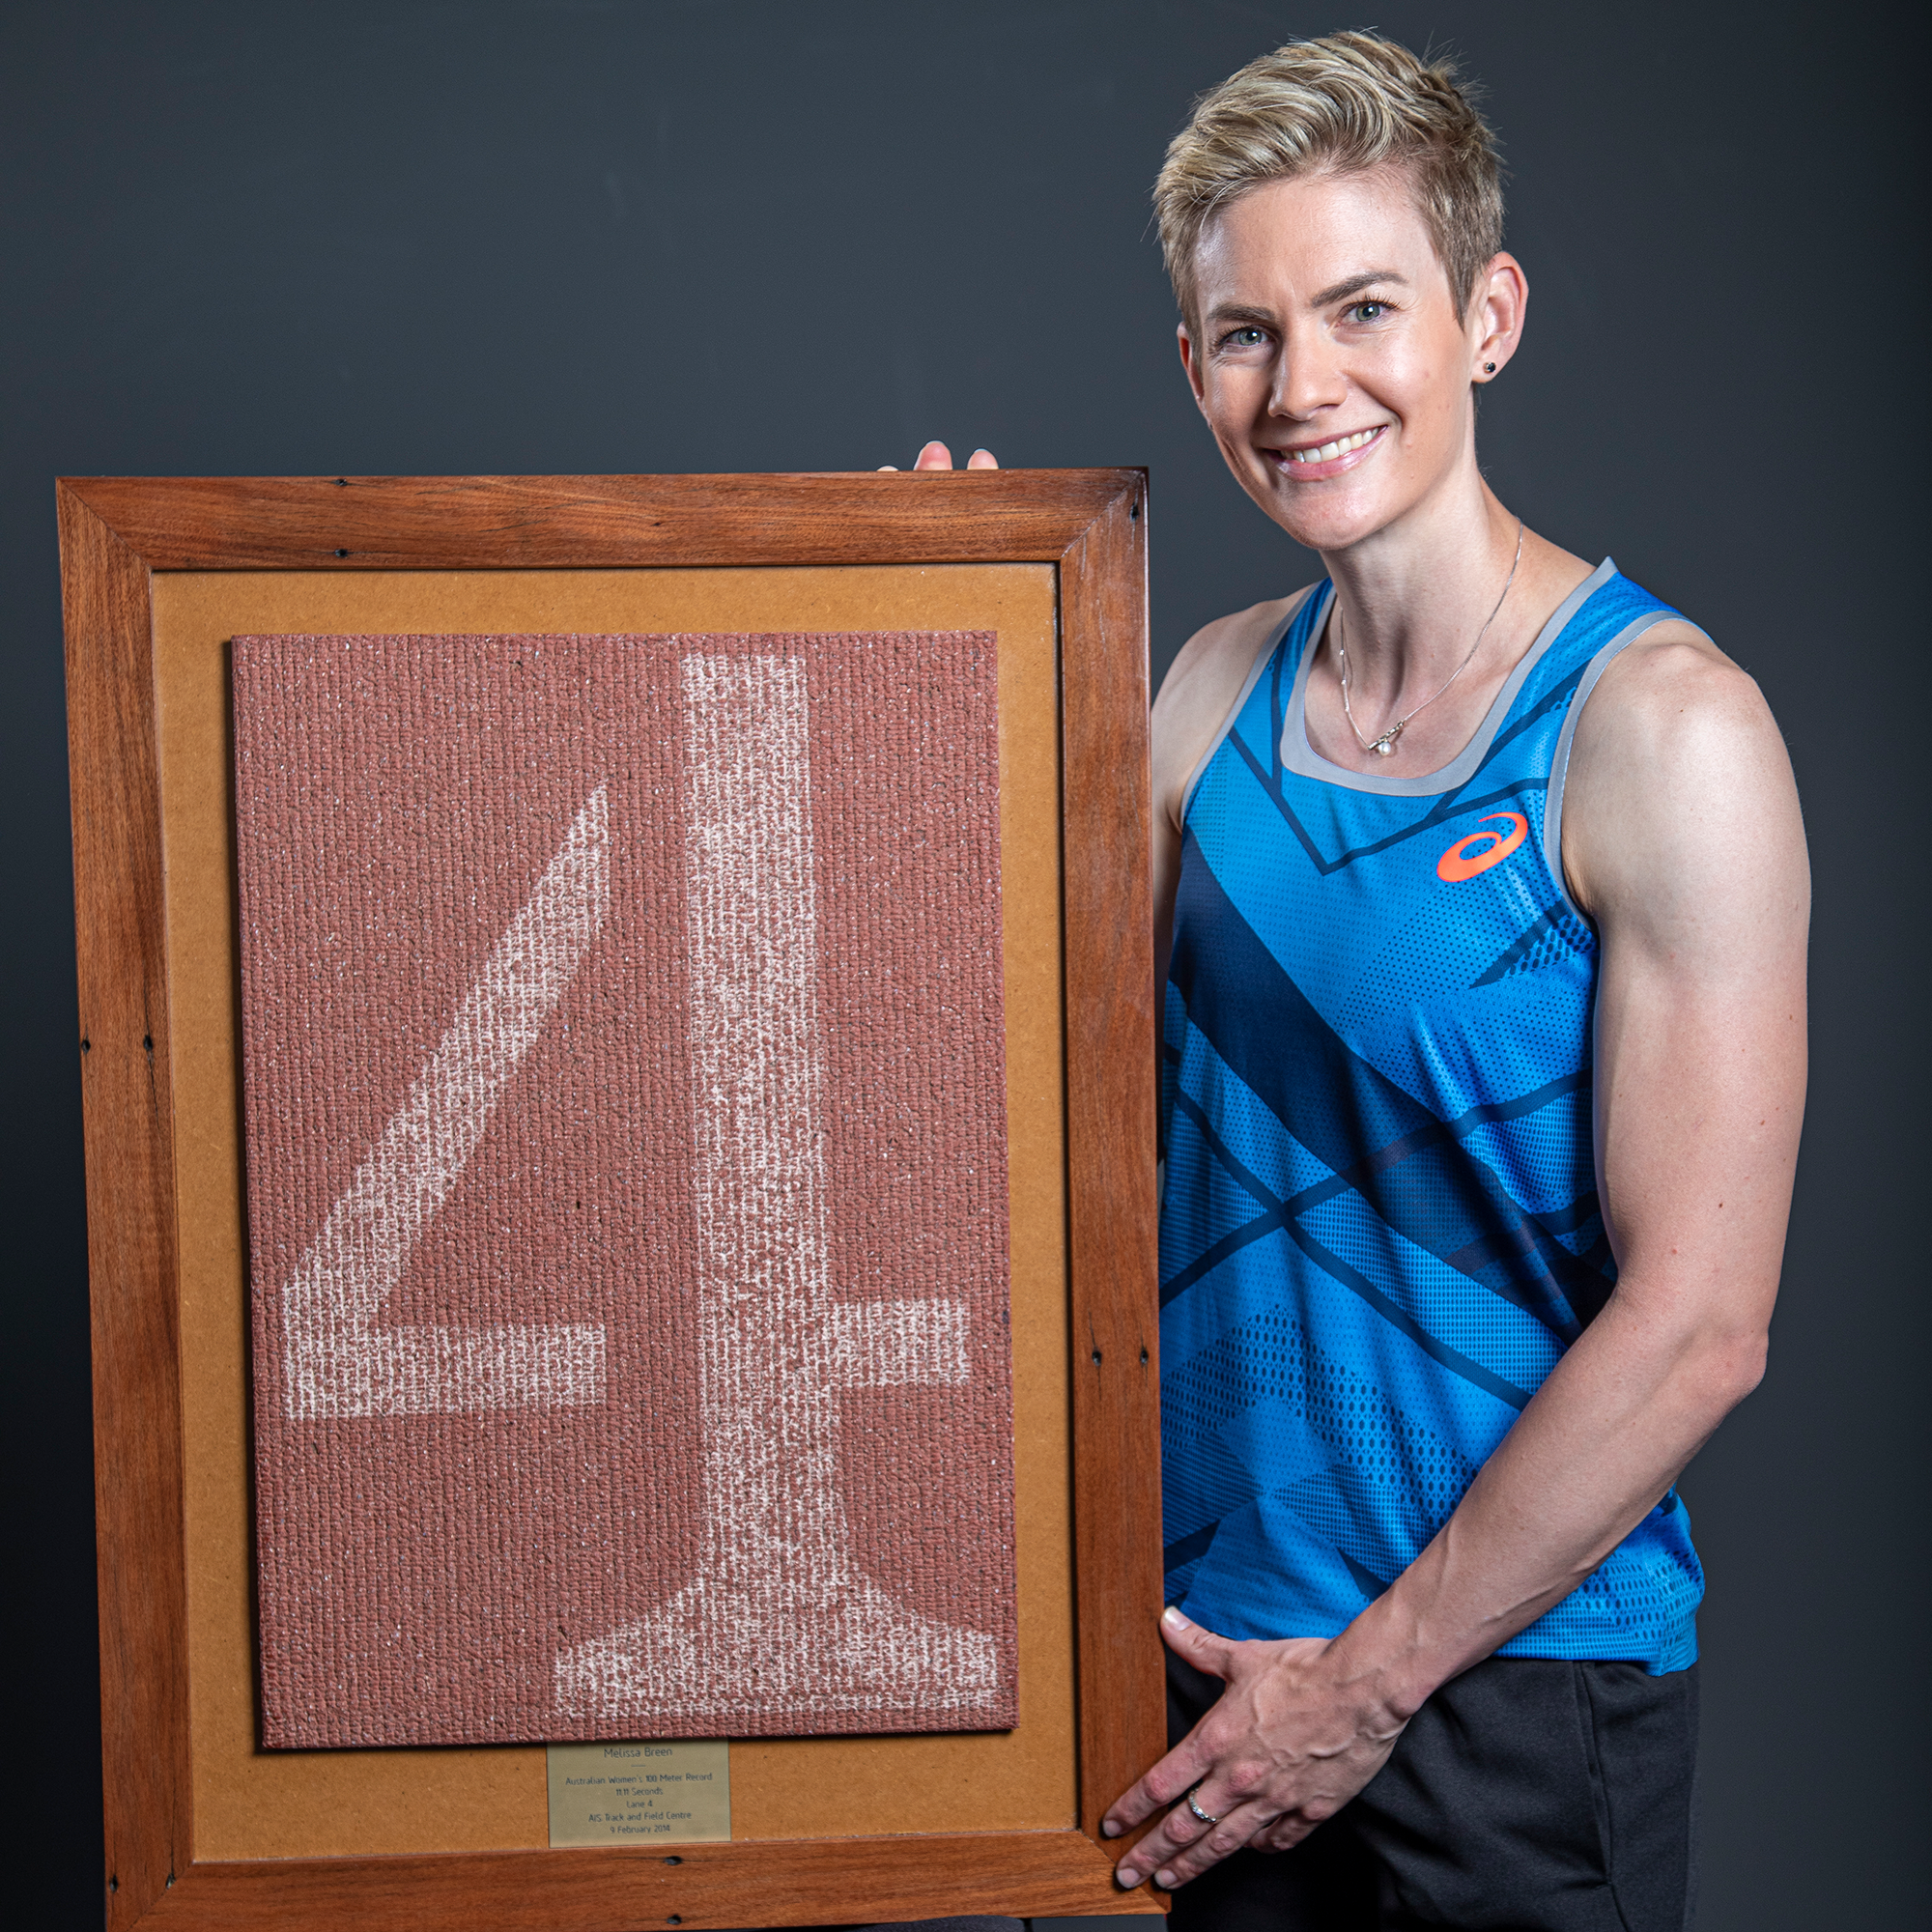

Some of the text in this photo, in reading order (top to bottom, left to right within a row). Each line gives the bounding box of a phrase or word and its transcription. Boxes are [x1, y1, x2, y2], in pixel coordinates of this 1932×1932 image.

[281, 653, 998, 1720] 4
[604, 1747, 672, 1758] Melissa Breen
[566, 1776, 605, 1785] Australian
[609, 1775, 642, 1784] Women's
[660, 1774, 682, 1782] Meter
[686, 1773, 712, 1781] Record
[632, 1787, 663, 1796] Seconds
[627, 1812, 640, 1821] and
[667, 1811, 692, 1820] Centre
[617, 1825, 650, 1833] February
